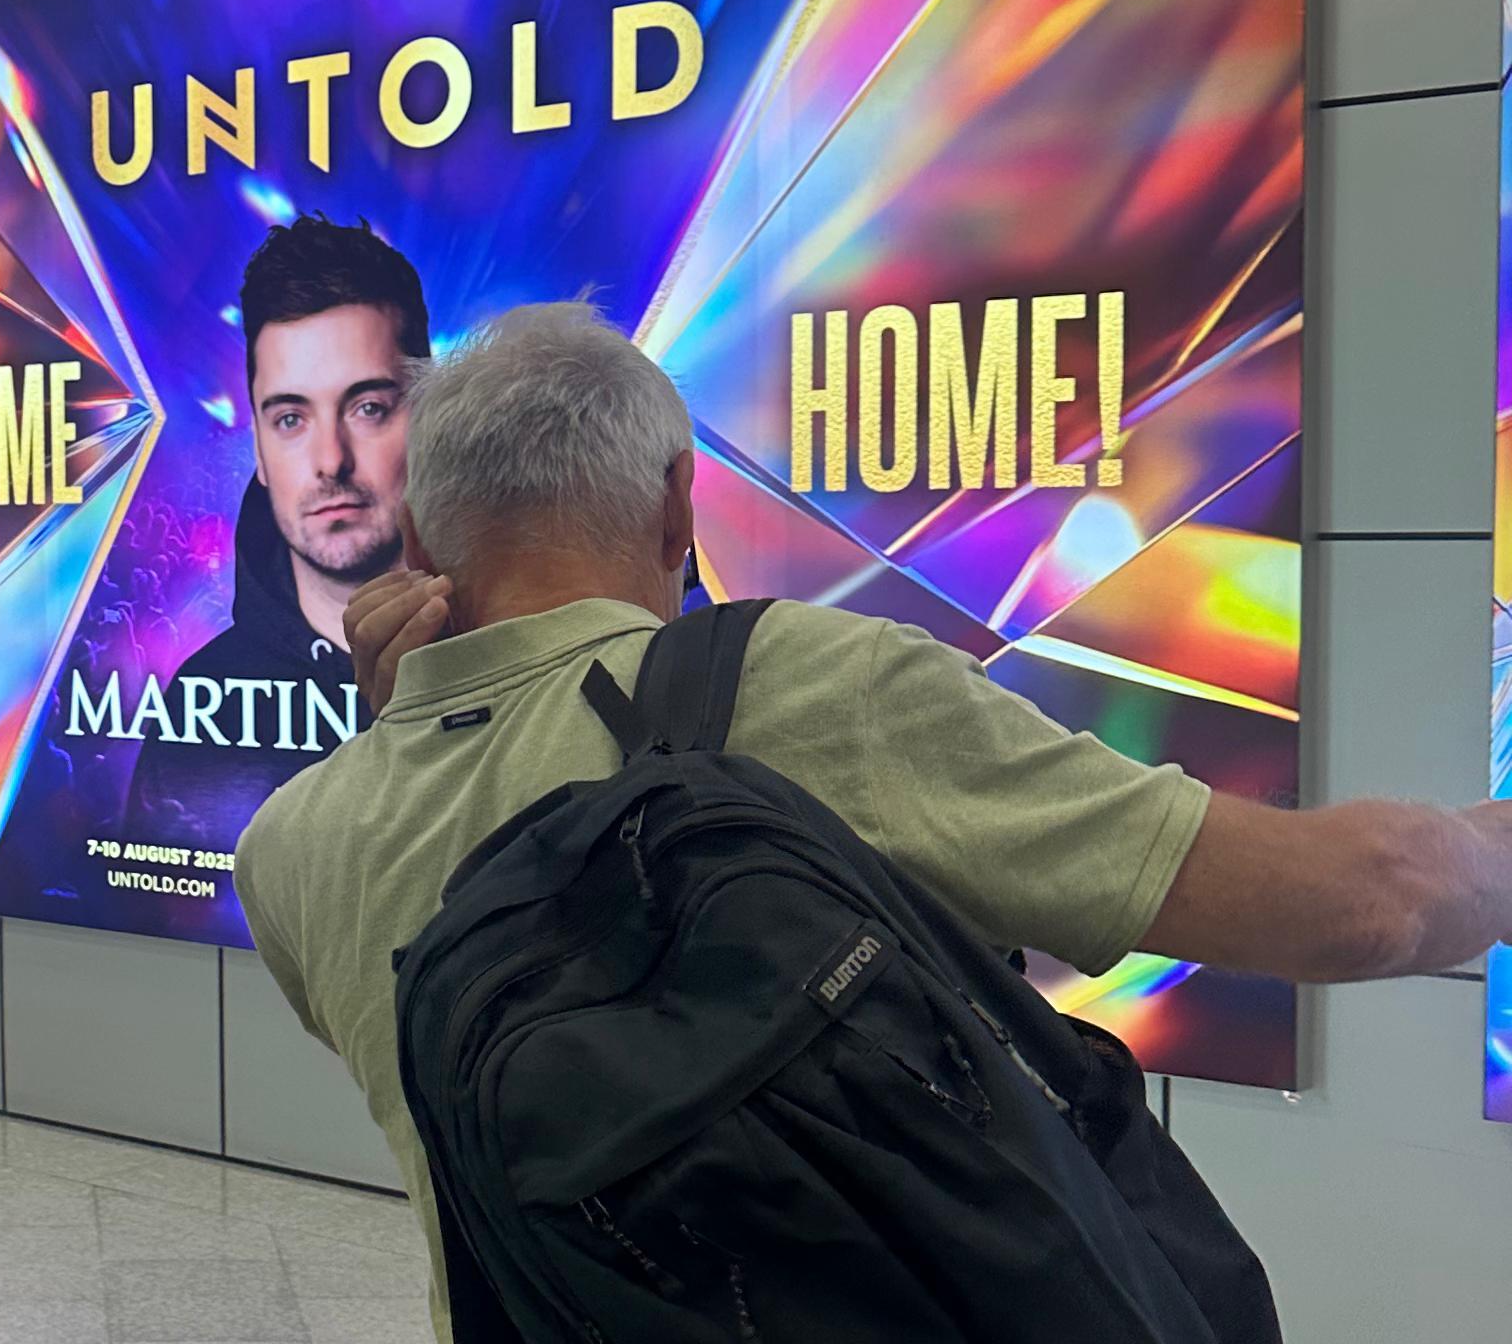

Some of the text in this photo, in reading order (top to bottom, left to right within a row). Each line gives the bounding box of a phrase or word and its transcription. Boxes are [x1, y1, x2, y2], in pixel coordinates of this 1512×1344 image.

[90, 0, 705, 186] UNTOLD
[791, 291, 1125, 493] HOME!
[65, 668, 359, 752] MARTIN
[87, 839, 236, 871] 7-10 AUGUST 2025
[107, 870, 215, 898] UNTOLD.COM
[819, 935, 883, 1002] BURTON
